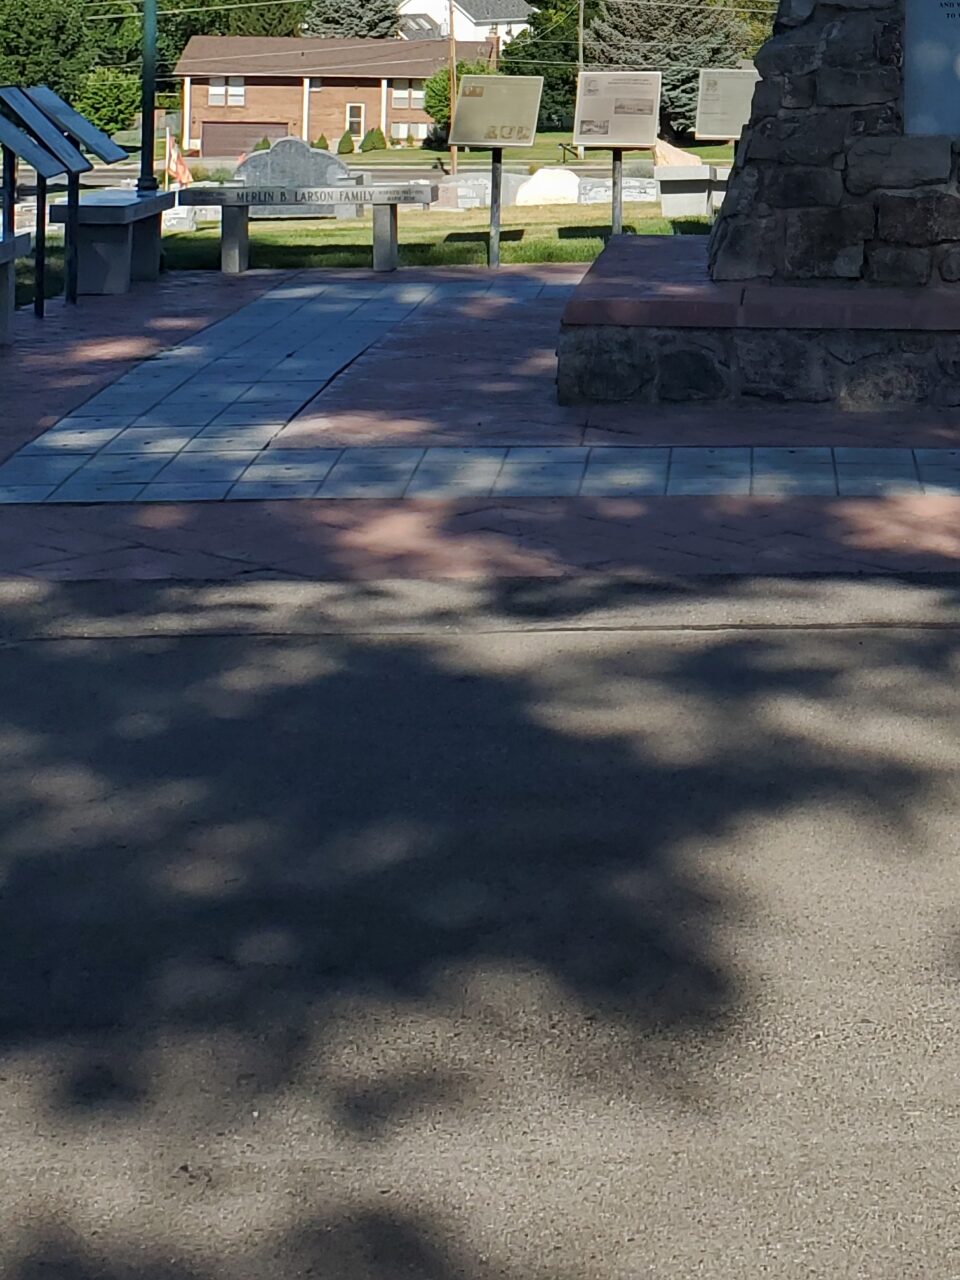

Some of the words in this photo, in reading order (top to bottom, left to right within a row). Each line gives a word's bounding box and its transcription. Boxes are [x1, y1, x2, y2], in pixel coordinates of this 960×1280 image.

[236, 191, 274, 203] MERLIN
[294, 191, 333, 203] LARSON
[339, 190, 375, 202] FAMILY
